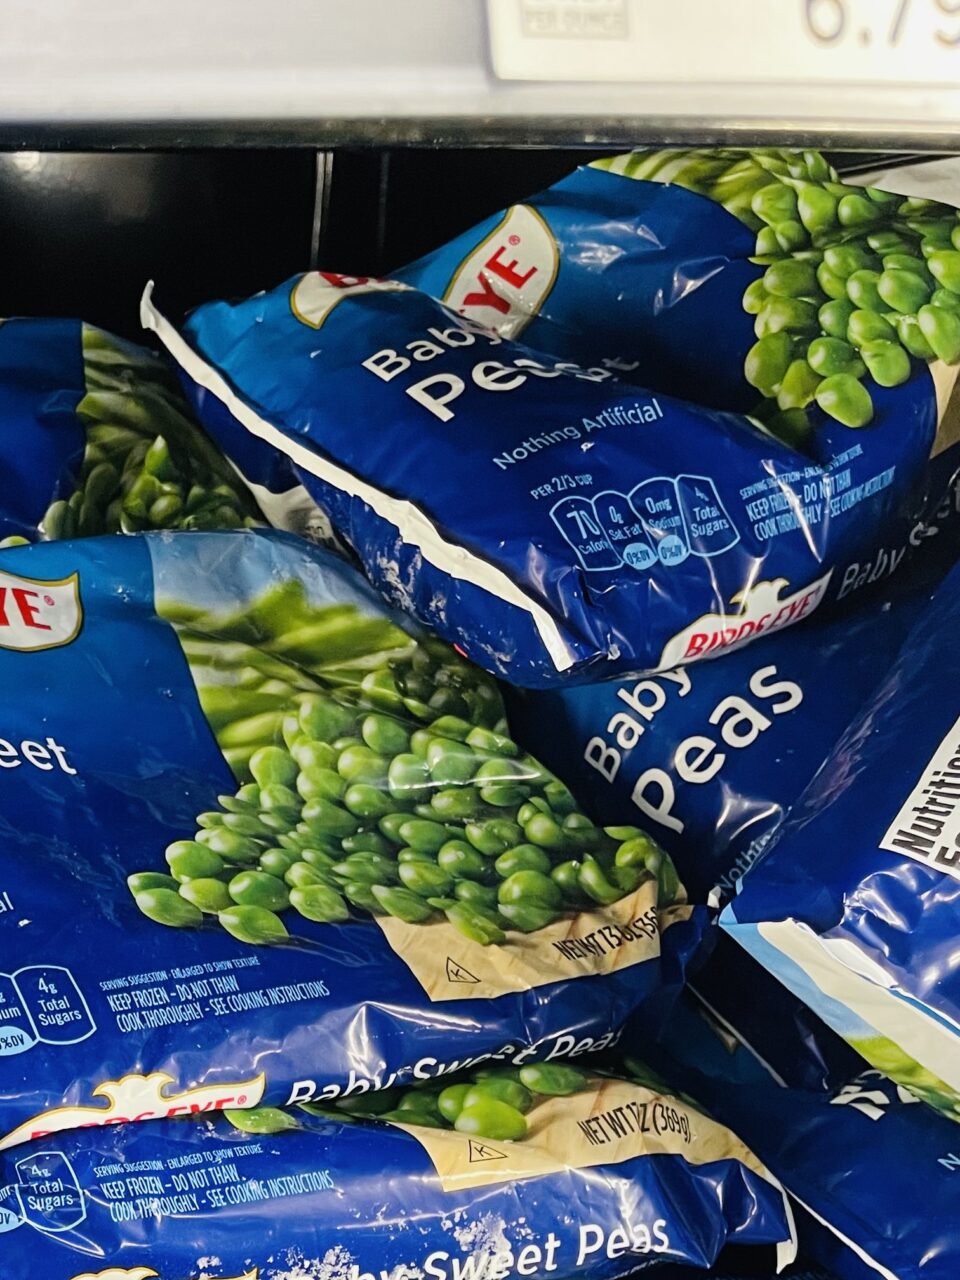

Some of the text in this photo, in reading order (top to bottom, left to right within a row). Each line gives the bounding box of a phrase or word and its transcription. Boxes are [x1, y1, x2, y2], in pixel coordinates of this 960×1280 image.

[492, 398, 663, 470] Nothing Artificial
[584, 666, 692, 784] Baby
[631, 664, 805, 834] Peas
[38, 995, 71, 1013] Total
[106, 974, 241, 1013] KEEP FROZEN DO NOT THAW
[38, 1009, 82, 1027] Sugars
[576, 1218, 670, 1266] Peas
